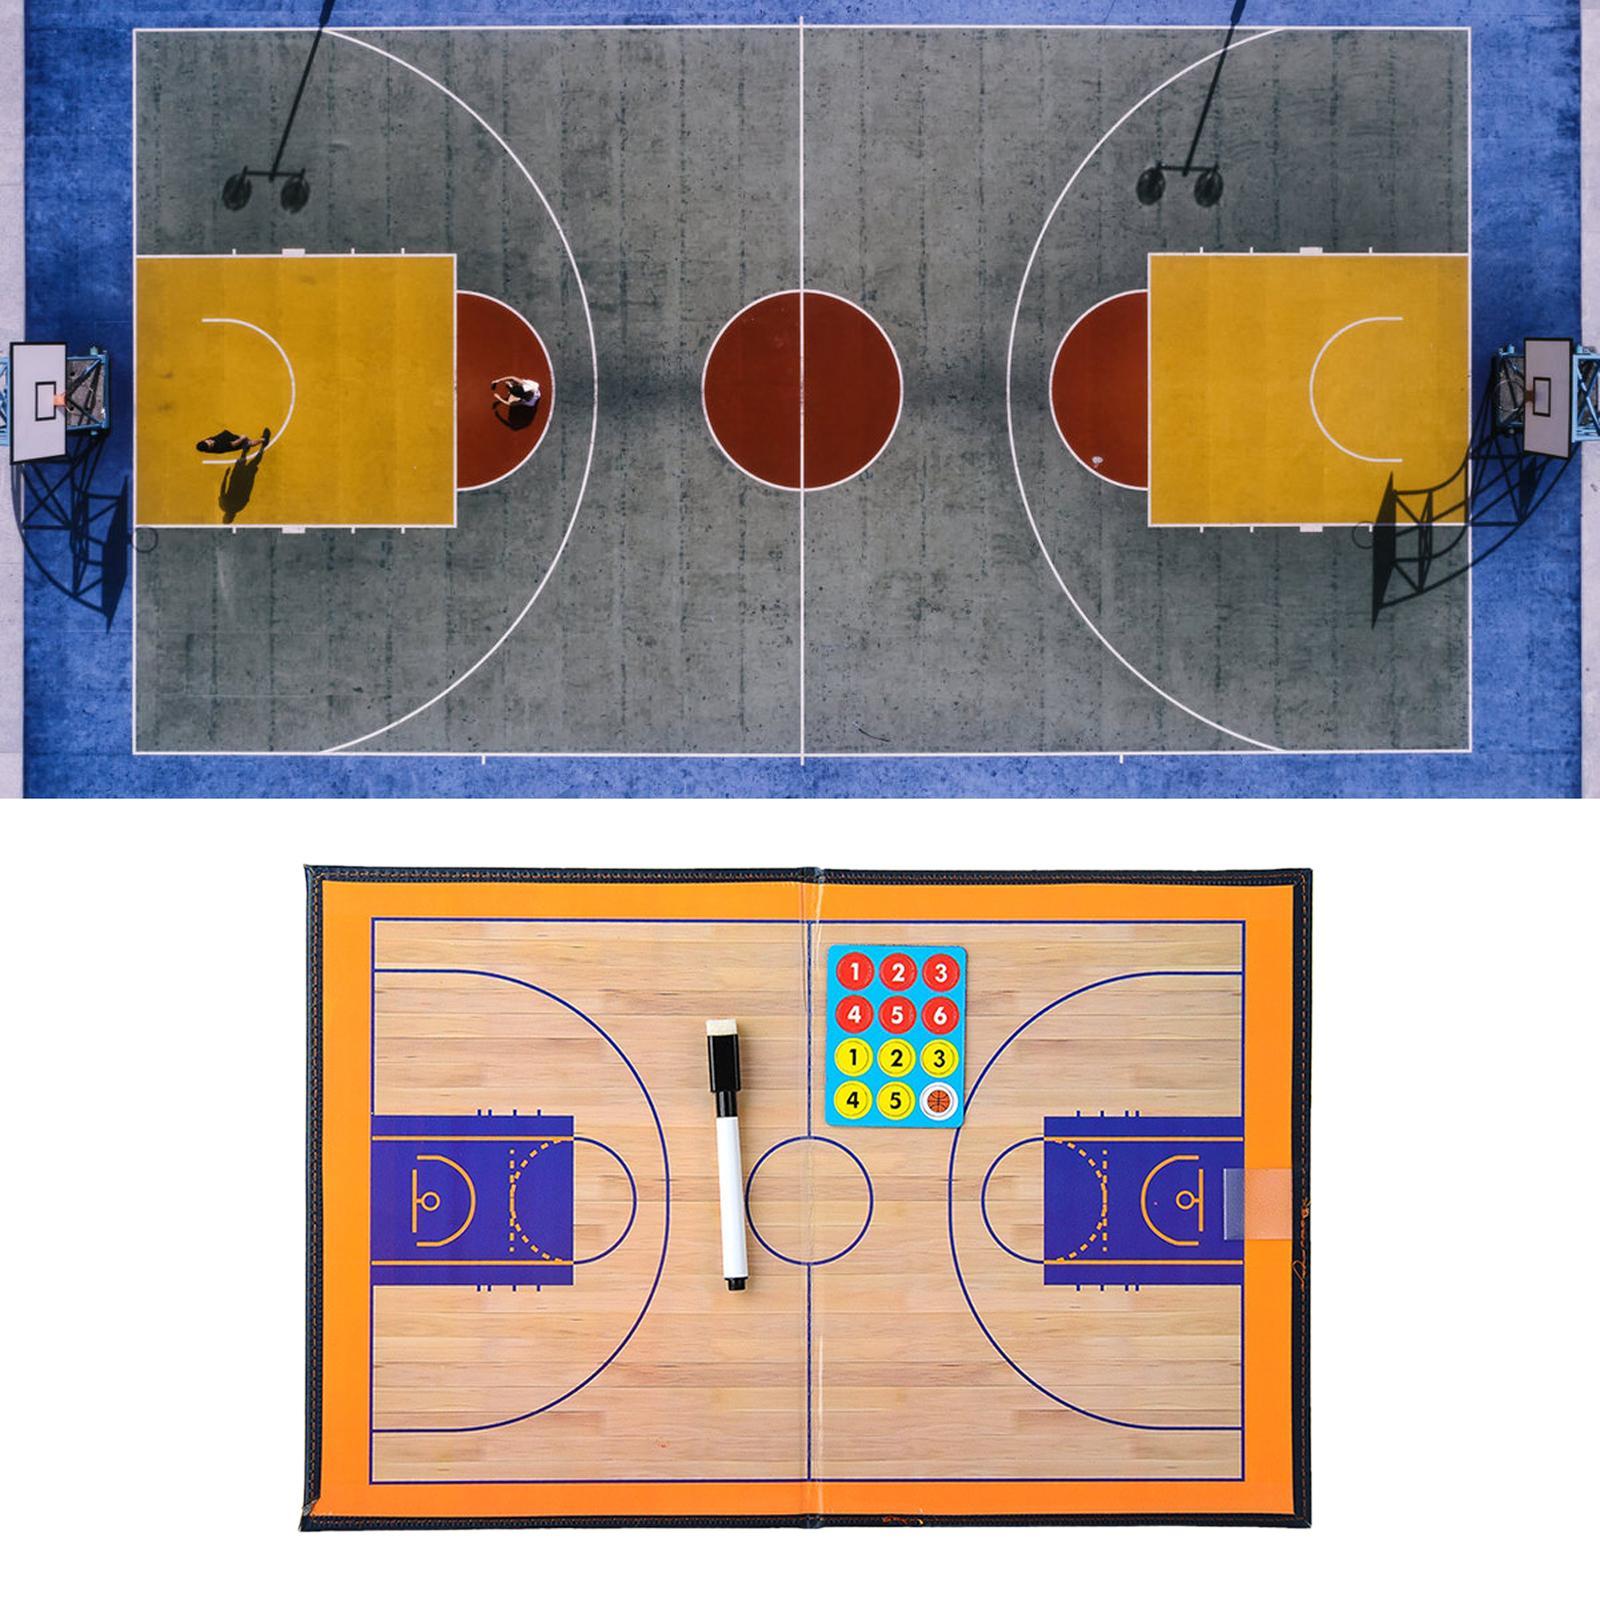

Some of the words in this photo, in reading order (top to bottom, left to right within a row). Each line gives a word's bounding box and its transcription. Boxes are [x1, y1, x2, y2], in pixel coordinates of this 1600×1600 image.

[850, 962, 859, 981] 1
[892, 963, 906, 982] 2
[934, 963, 948, 983] 3
[847, 1005, 862, 1024] 4
[890, 1006, 904, 1025] 5
[933, 1006, 948, 1025] 6
[849, 1048, 857, 1066] 1
[890, 1049, 903, 1067] 2
[933, 1049, 946, 1068] 3
[846, 1091, 860, 1109] 4
[889, 1092, 902, 1109] 5
